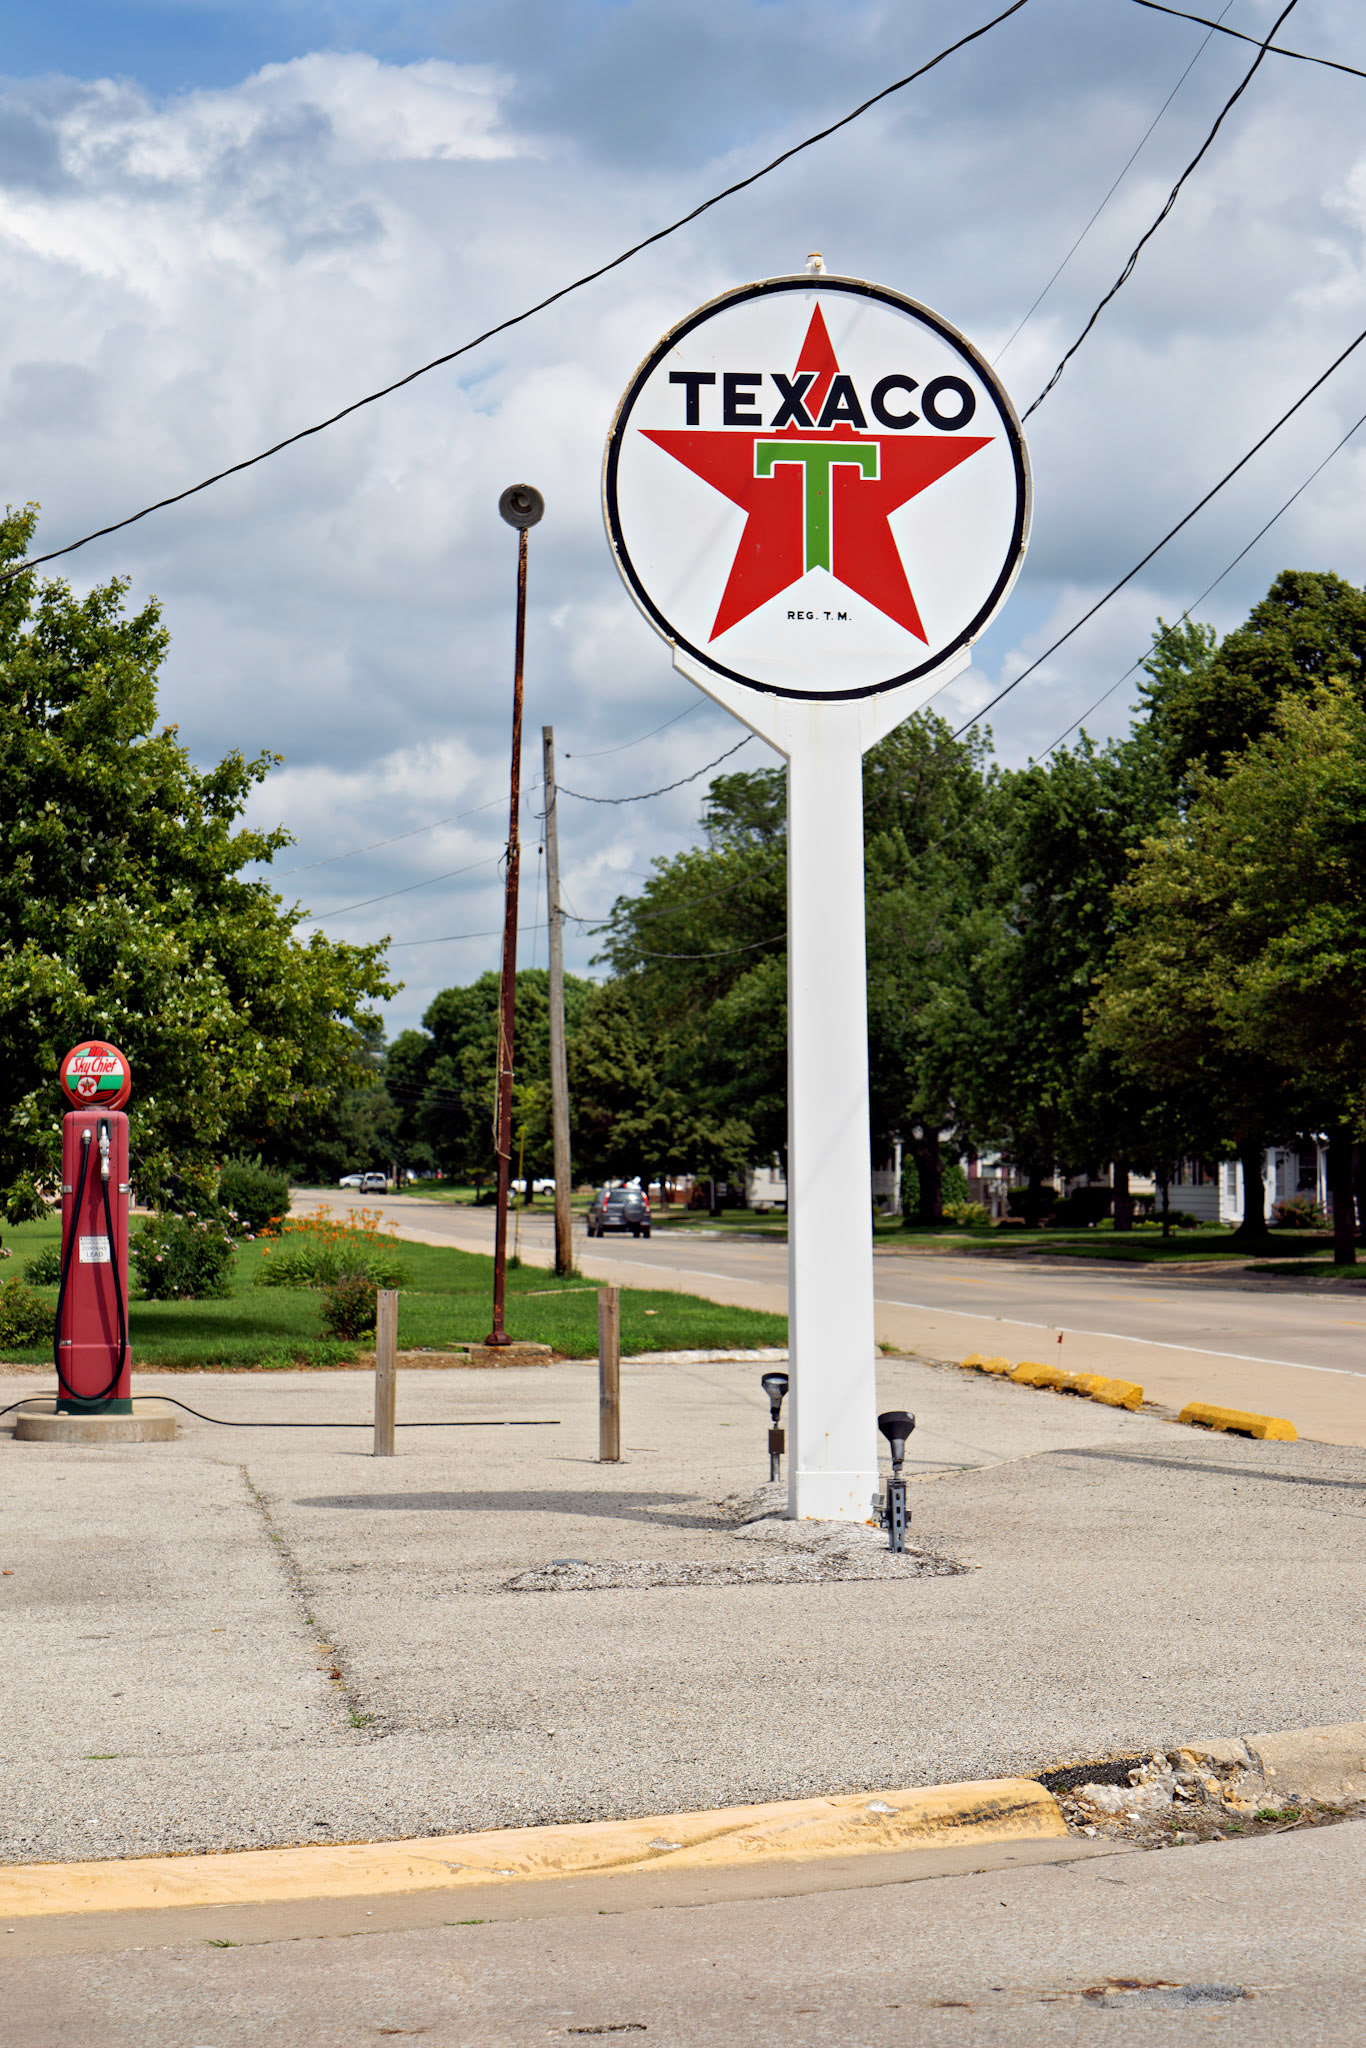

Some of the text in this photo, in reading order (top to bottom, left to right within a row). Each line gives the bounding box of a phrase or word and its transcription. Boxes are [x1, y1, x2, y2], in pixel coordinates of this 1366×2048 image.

[669, 371, 976, 431] TEXACO
[754, 440, 881, 573] T
[787, 610, 819, 620] REG.
[72, 1057, 117, 1075] Sky Chief
